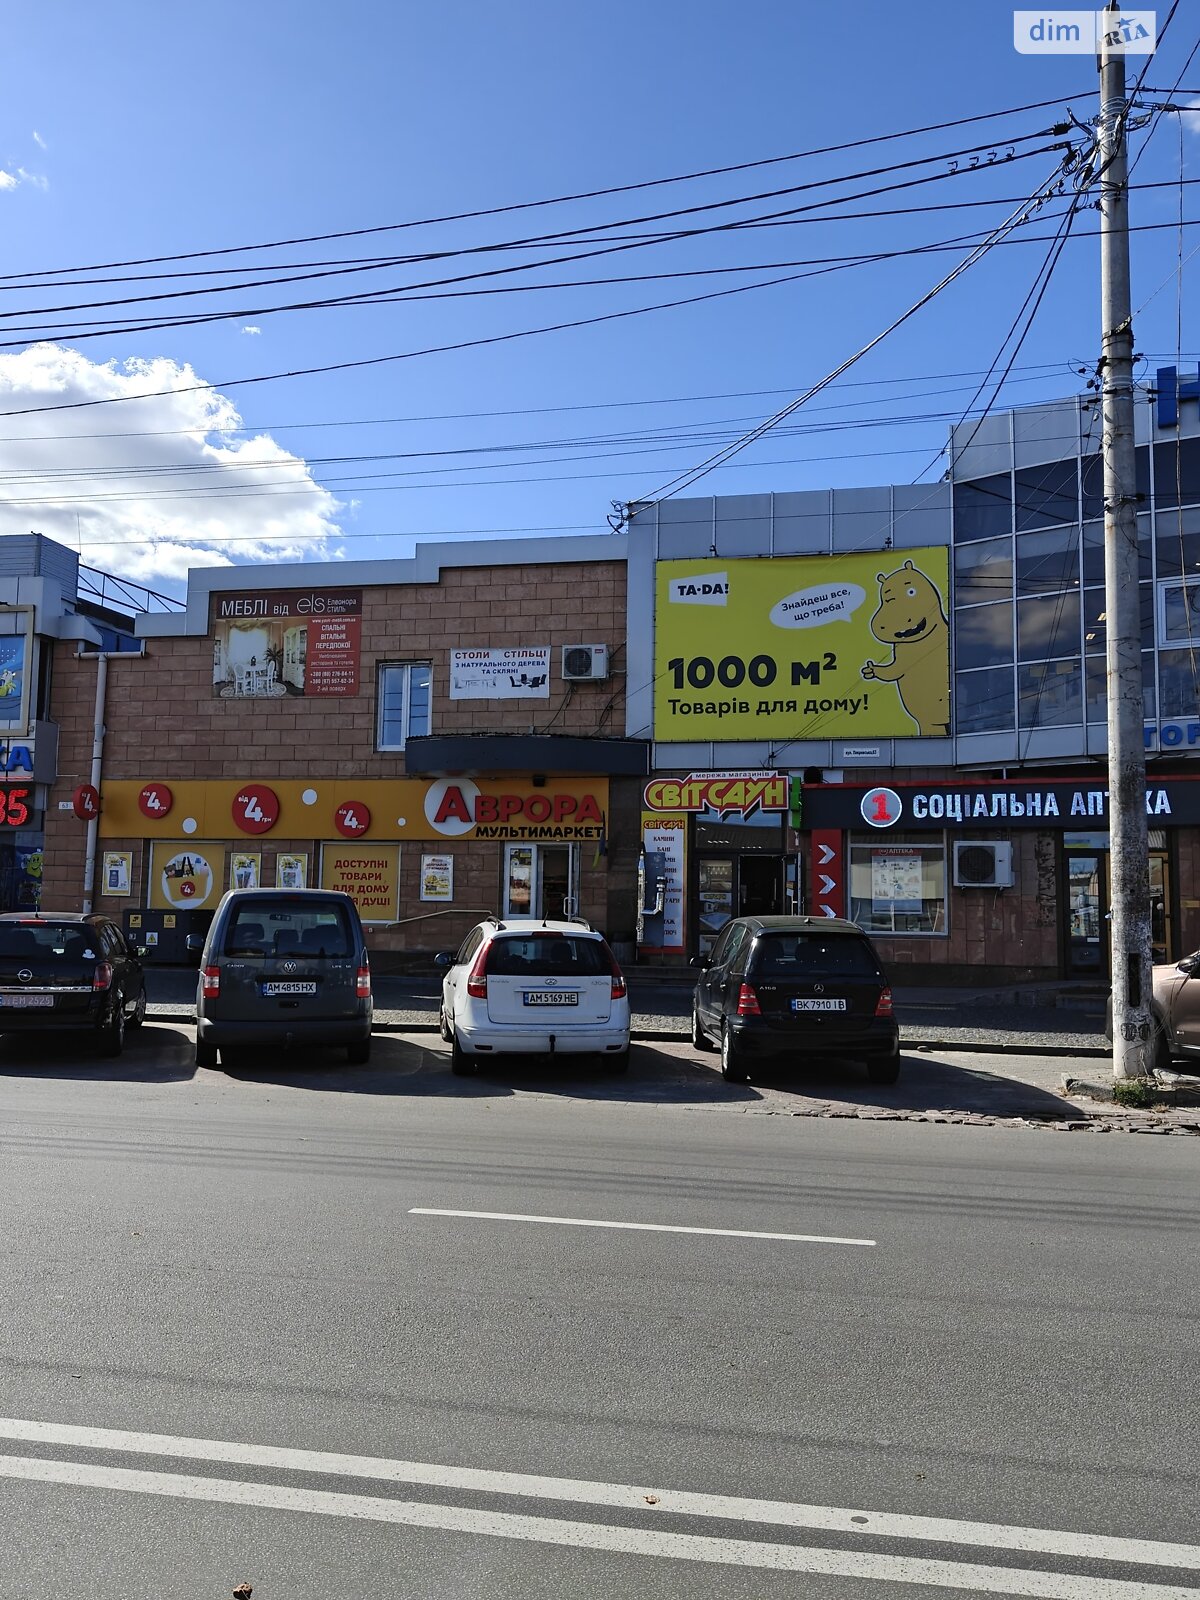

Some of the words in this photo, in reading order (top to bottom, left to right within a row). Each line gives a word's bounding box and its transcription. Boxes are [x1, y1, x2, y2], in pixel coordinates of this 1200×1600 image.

[221, 599, 268, 616] МЕБЛІ
[273, 603, 289, 616] від
[781, 593, 829, 612] Знайдеш
[830, 589, 852, 600] все,
[794, 611, 810, 622] що
[811, 601, 845, 618] треба!
[315, 640, 351, 650] ПЕРЕДПОКОЇ
[455, 651, 490, 659] СТОЛИ
[504, 650, 547, 659] СТІЛЬЦІ
[668, 654, 777, 690] 1000
[668, 697, 750, 718] Товарів
[756, 700, 797, 716] для
[804, 694, 869, 716] дому!
[695, 772, 726, 780] мережа
[728, 771, 770, 779] магазинів
[84, 793, 93, 812] 4
[147, 791, 160, 811] 4
[648, 782, 709, 808] СВІТ
[707, 781, 785, 813] САУН
[238, 795, 249, 804] від
[244, 796, 263, 822] 4
[871, 792, 892, 821] 1
[912, 792, 1060, 822] СОЦІАЛЬНА
[1070, 790, 1172, 817] АПКА
[344, 809, 358, 828] 4
[475, 826, 603, 838] МУЛЬТИМАРКЕТ
[334, 859, 388, 869] ДОСТУПНІ
[340, 872, 382, 881] ТОВАРИ
[357, 885, 390, 895] ДОМУ
[361, 897, 391, 907] ДУШІ
[268, 983, 280, 992] AM
[281, 983, 301, 992] 4815
[301, 983, 314, 992] HX
[529, 995, 543, 1003] AM
[544, 995, 562, 1003] 5169
[564, 995, 577, 1003] HE
[797, 1000, 809, 1010] BK
[810, 1000, 831, 1010] 7910
[833, 1000, 845, 1010] IB
